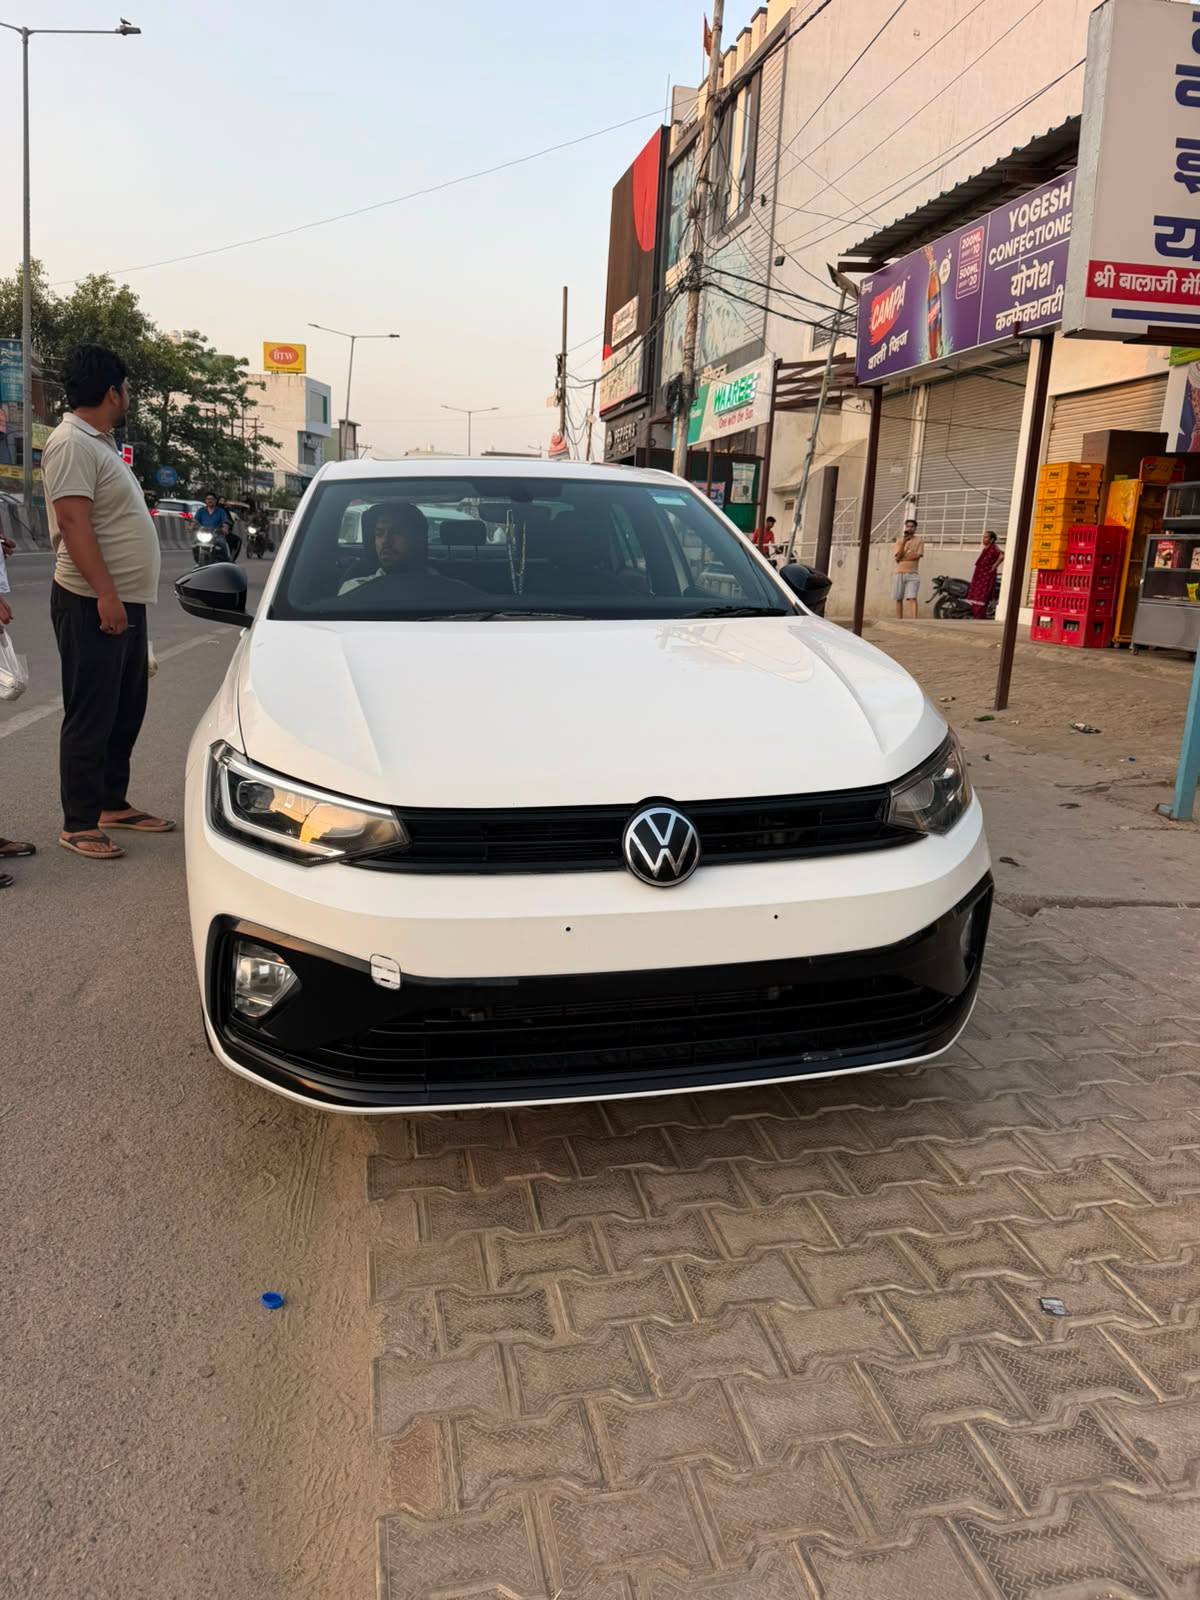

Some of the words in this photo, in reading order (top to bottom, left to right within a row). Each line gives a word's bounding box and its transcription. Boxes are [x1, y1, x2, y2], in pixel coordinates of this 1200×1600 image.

[1009, 181, 1073, 233] YOGESH
[1010, 259, 1055, 297] योगेश
[1094, 264, 1117, 289] श्री
[1119, 268, 1179, 294] बालाजी
[871, 280, 906, 331] CAMPA
